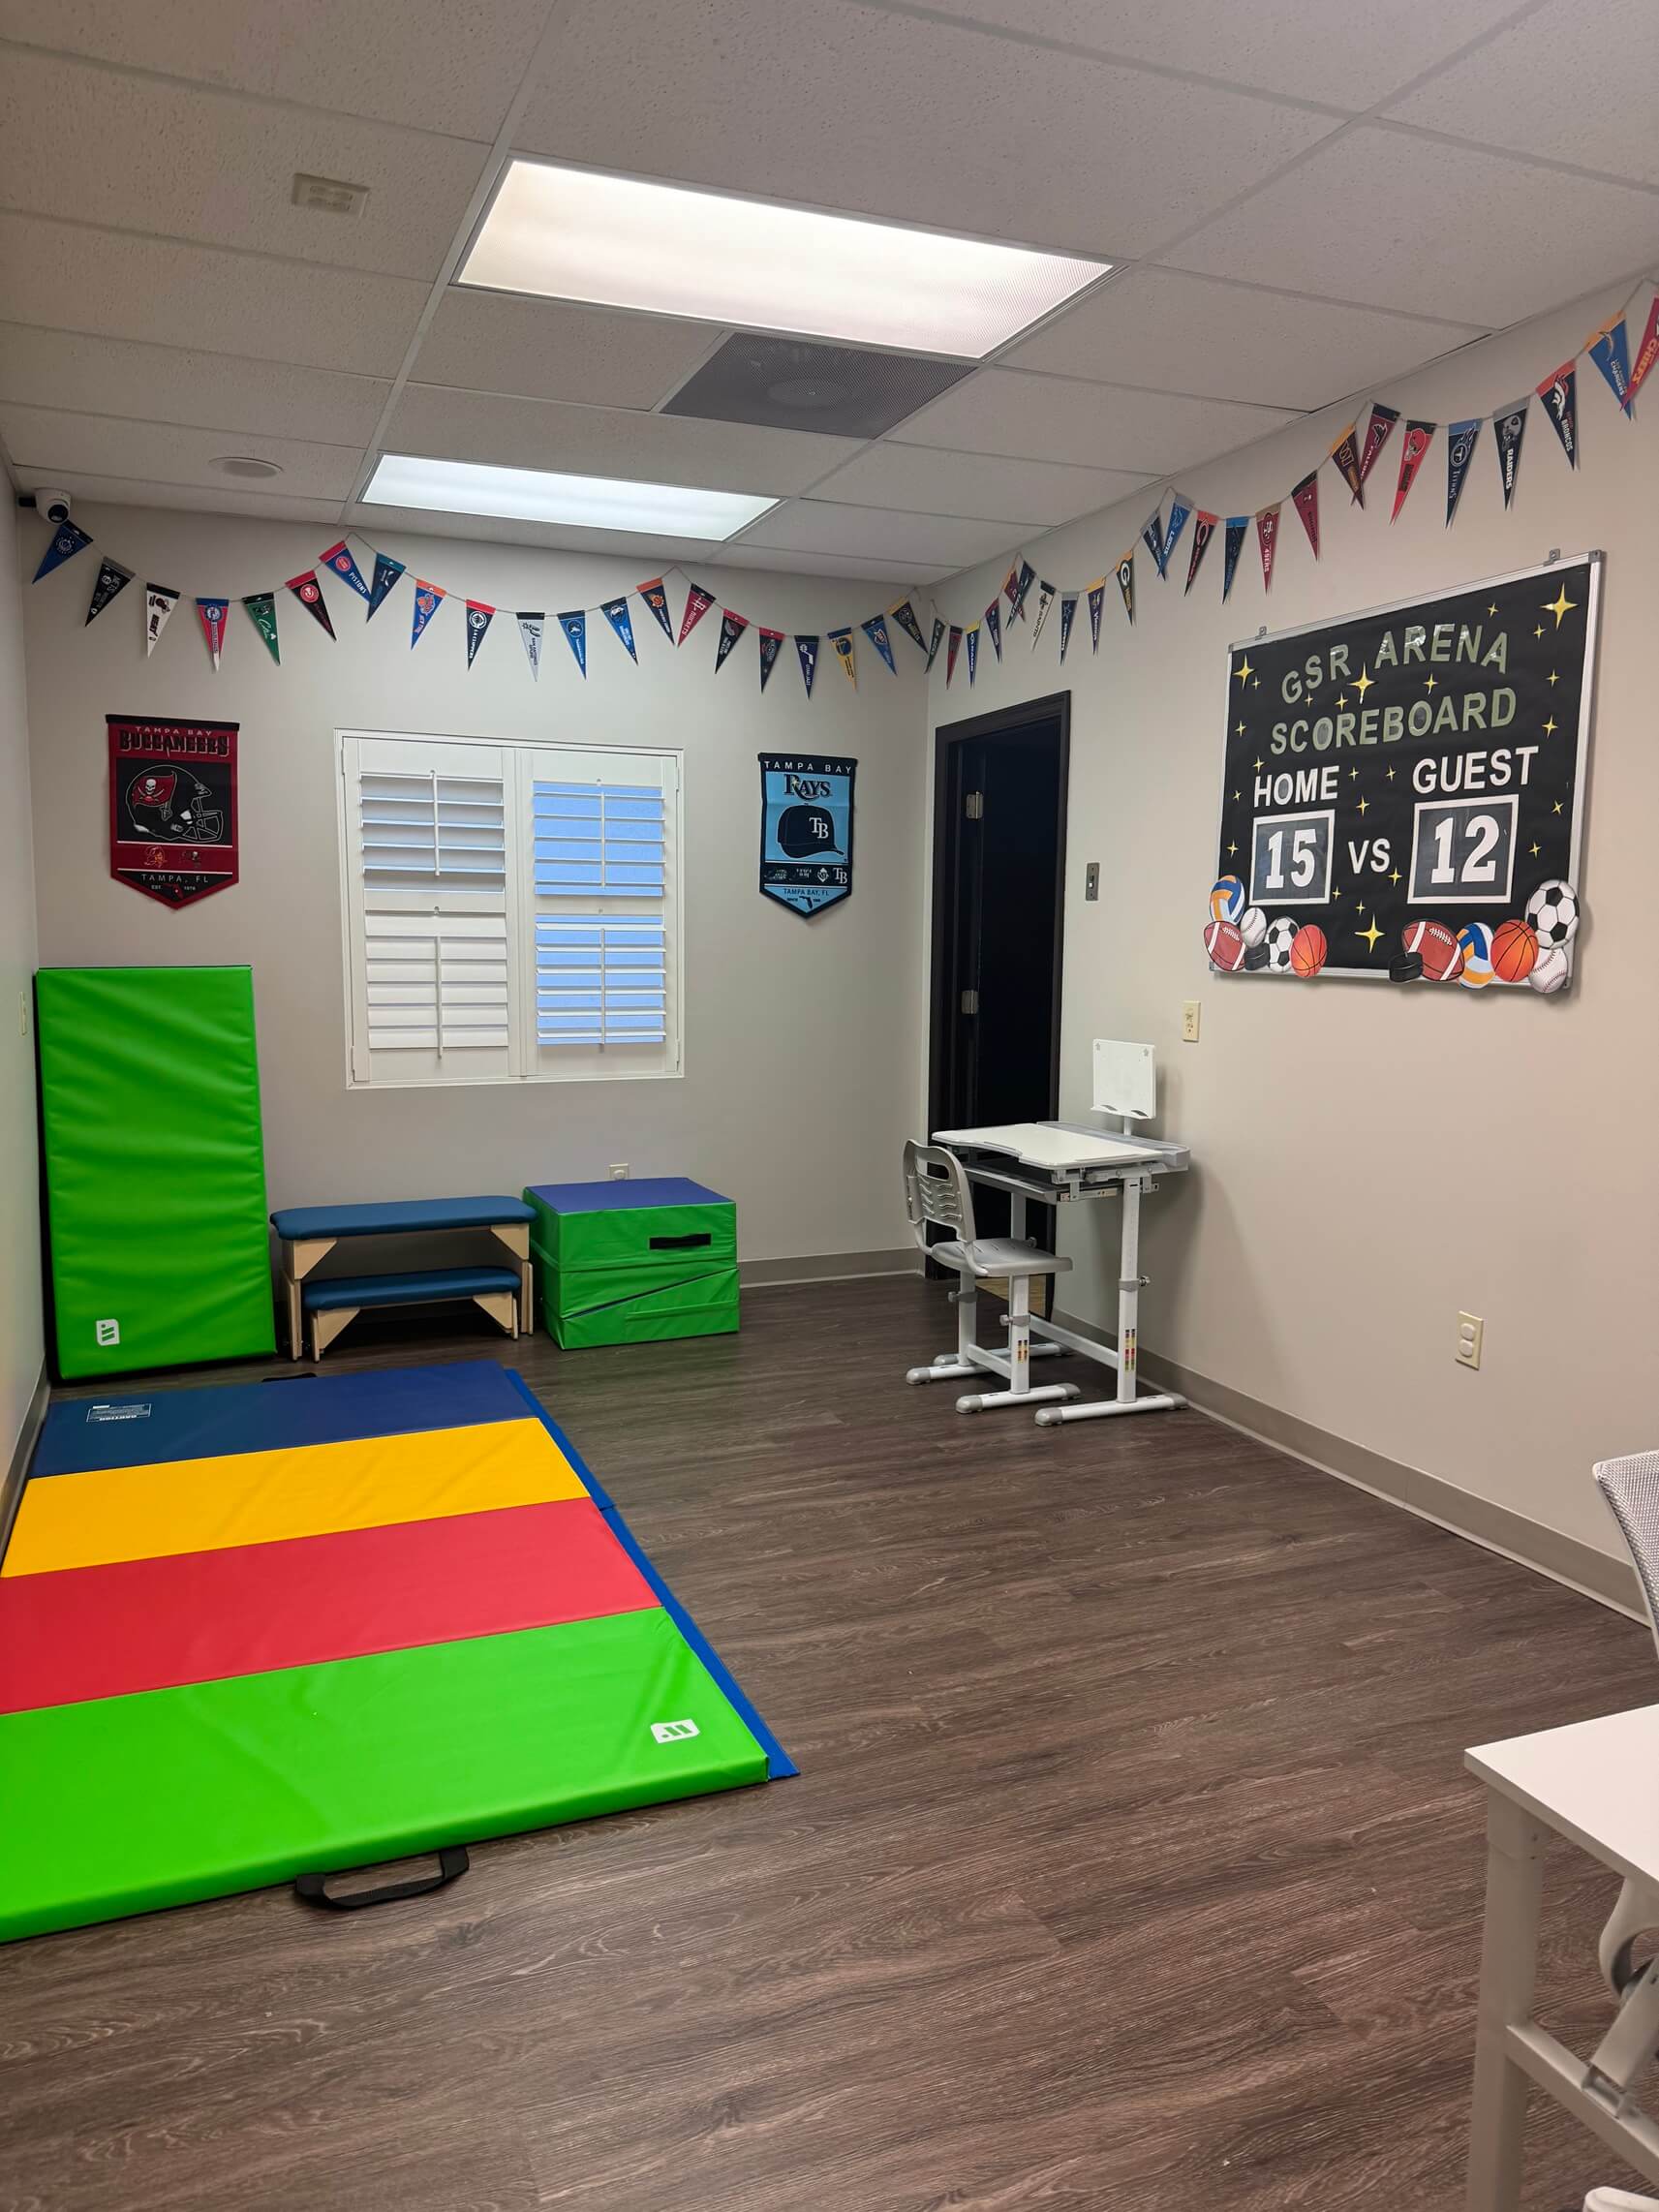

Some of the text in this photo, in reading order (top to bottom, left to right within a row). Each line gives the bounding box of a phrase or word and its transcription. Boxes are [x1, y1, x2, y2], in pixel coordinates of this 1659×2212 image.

[1632, 338, 1658, 384] CHIEFS
[1561, 419, 1574, 451] BRONCOS
[1163, 531, 1175, 556] LIONS
[1263, 548, 1272, 572] 49ERS
[349, 571, 367, 594] PISTONS
[149, 614, 160, 637] HEAT
[681, 611, 696, 636] ROCKETS
[1281, 623, 1508, 704] GSR ARENA
[1270, 687, 1517, 755] SCOREBOARD
[119, 729, 230, 758] BUCCANEERS
[764, 760, 852, 774] TAMPA BAY
[1253, 746, 1540, 808] HOME GUEST
[809, 817, 829, 840] TB
[1265, 814, 1500, 889] 15 VS 12
[833, 867, 848, 884] TB
